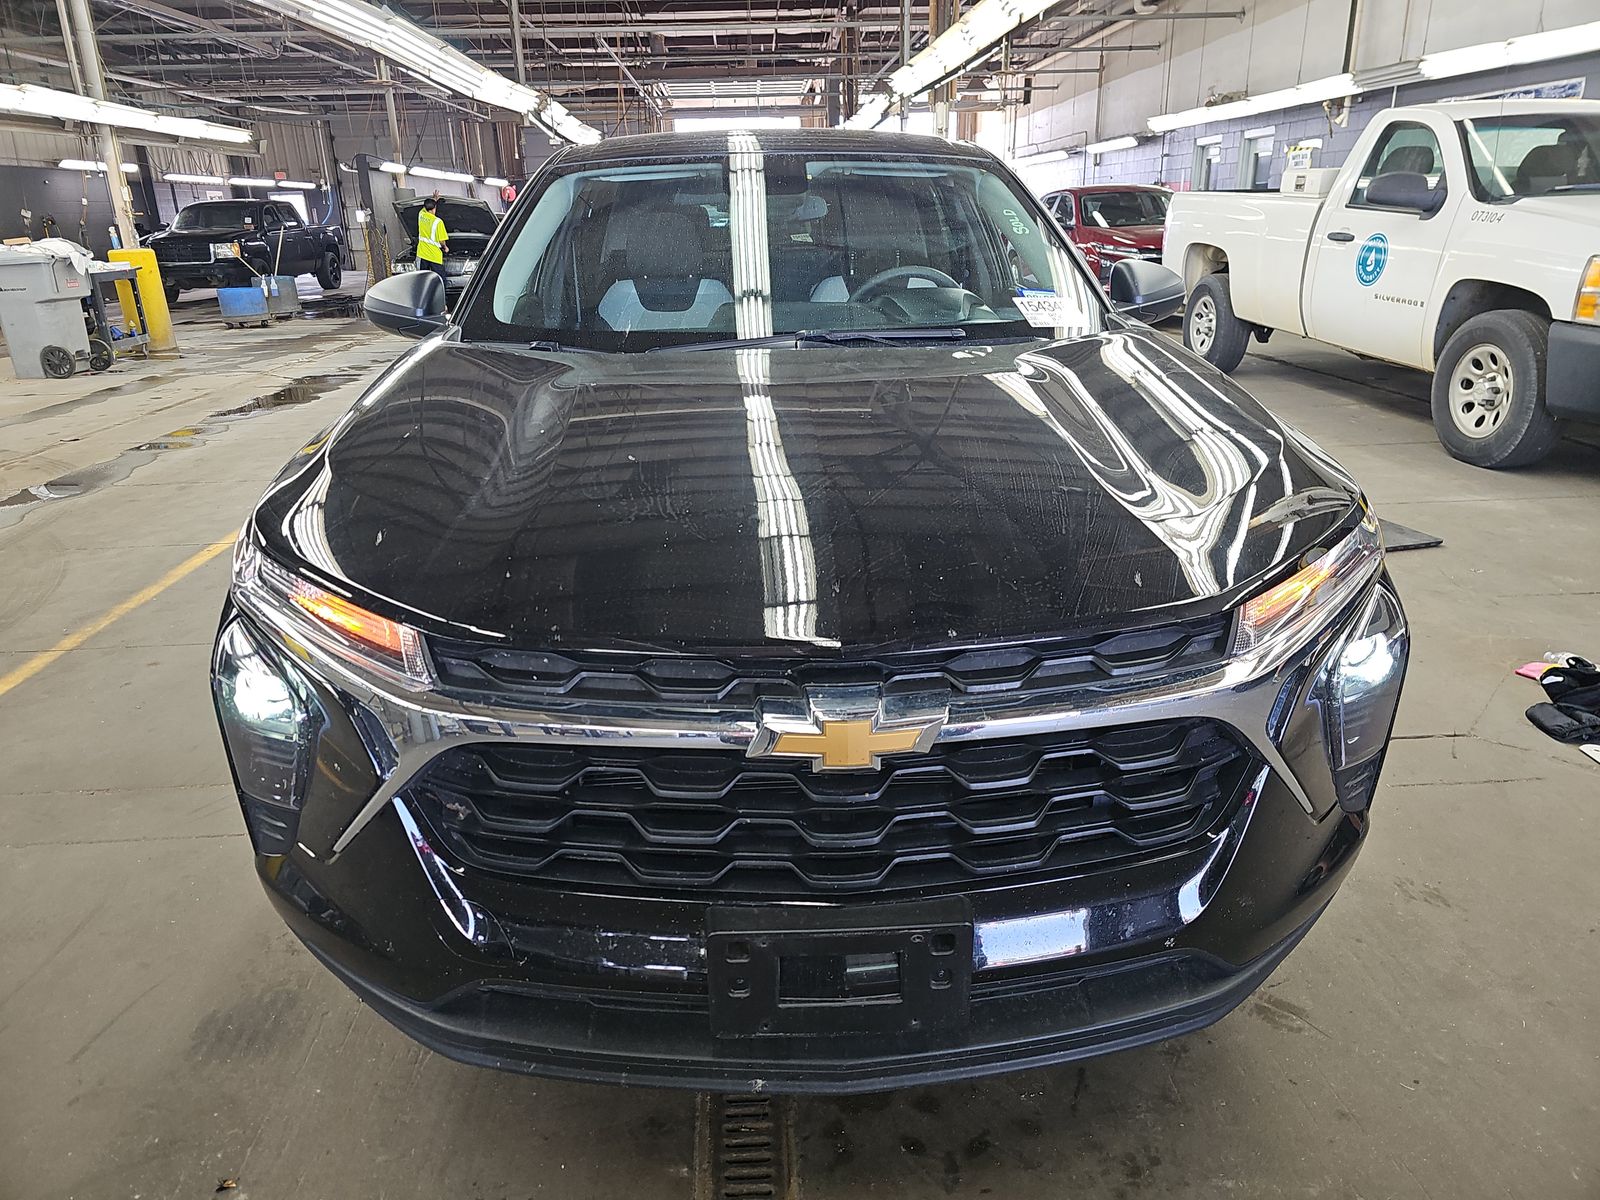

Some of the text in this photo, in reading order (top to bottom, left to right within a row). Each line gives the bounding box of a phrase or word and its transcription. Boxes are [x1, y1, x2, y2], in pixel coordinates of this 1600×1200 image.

[1003, 209, 1030, 235] SOLD
[1471, 210, 1505, 223] 073104
[1020, 300, 1065, 312] 15434
[1374, 293, 1419, 307] SILVERADO
